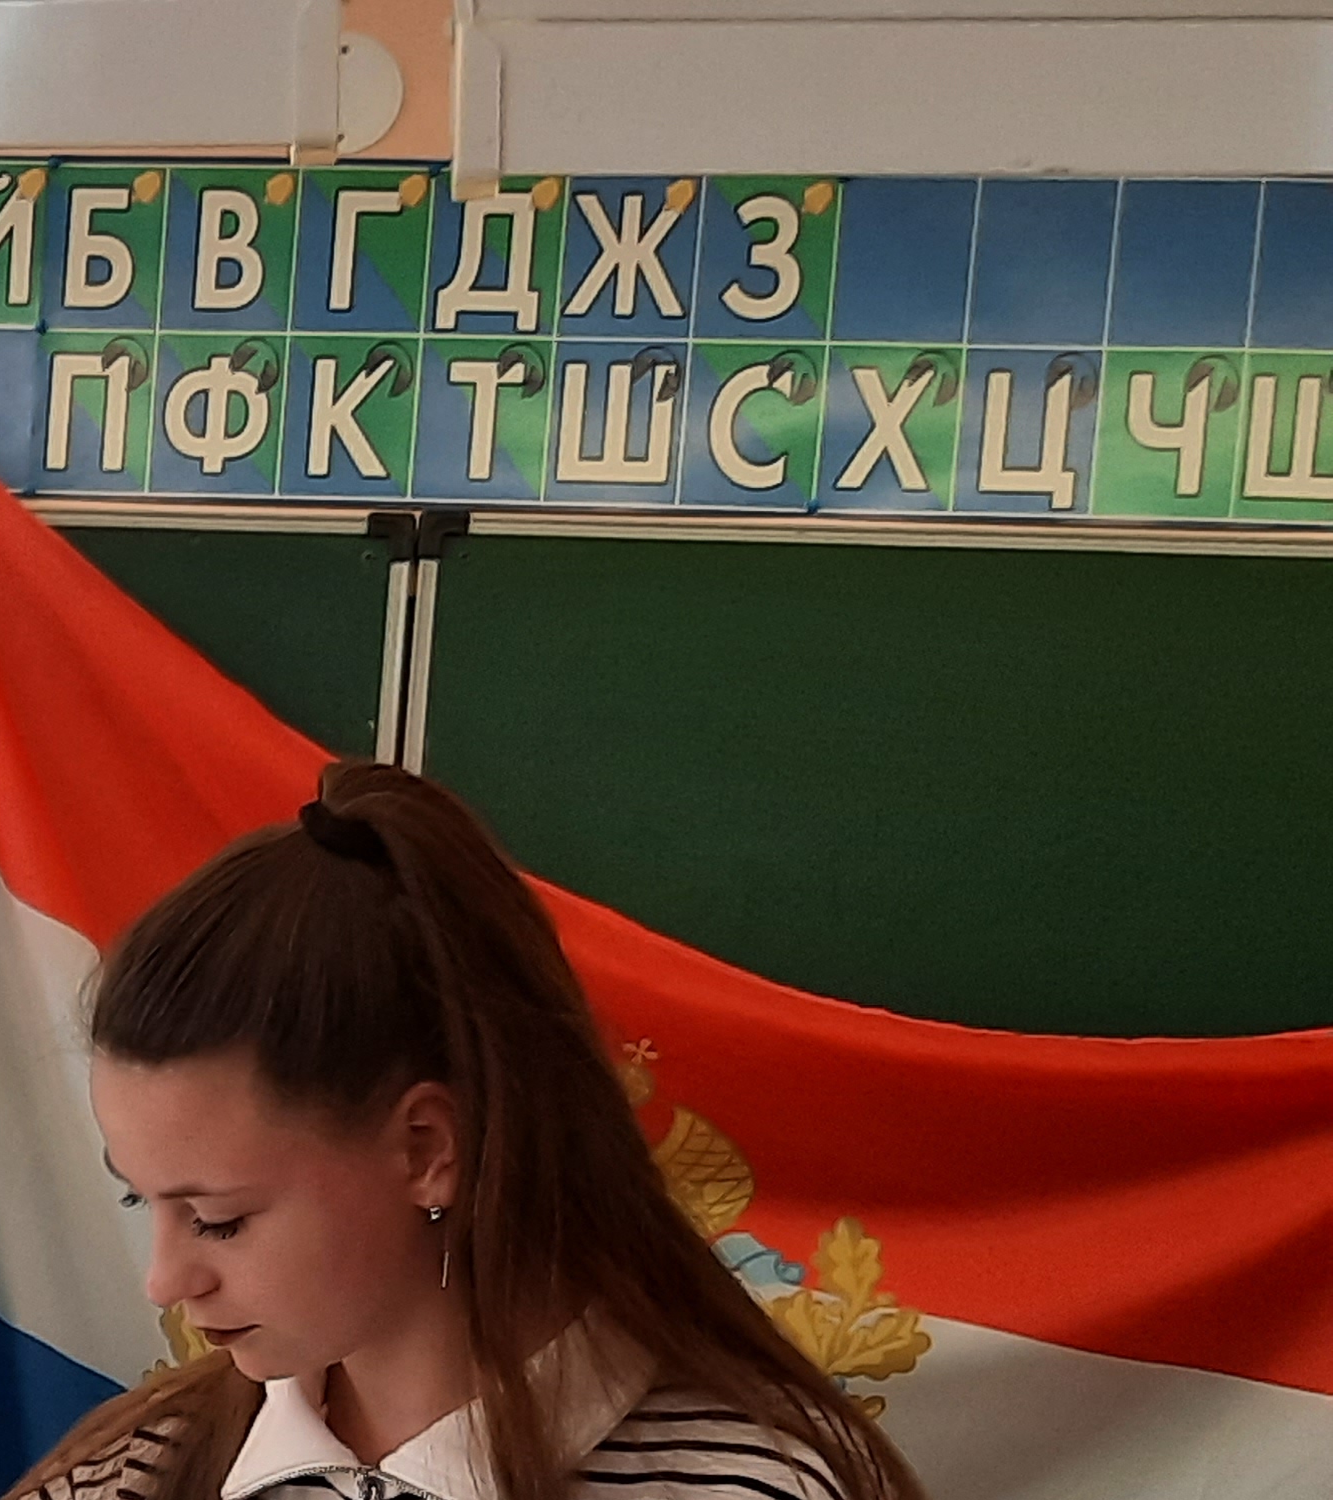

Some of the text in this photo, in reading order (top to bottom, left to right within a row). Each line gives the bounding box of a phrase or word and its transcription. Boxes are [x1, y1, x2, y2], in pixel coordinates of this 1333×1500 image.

[62, 187, 134, 309] Б
[193, 189, 265, 311] В
[327, 189, 404, 312] Г
[433, 191, 539, 333] Д
[562, 191, 686, 318] Ж
[720, 195, 803, 321] З
[44, 352, 132, 473] П
[162, 354, 271, 476] Ф
[305, 357, 398, 478] К
[447, 359, 526, 482] Т
[554, 362, 678, 484] Ш
[708, 362, 796, 490] С
[834, 366, 936, 492] Х
[976, 368, 1075, 510] Ц
[1124, 372, 1215, 498] Ч
